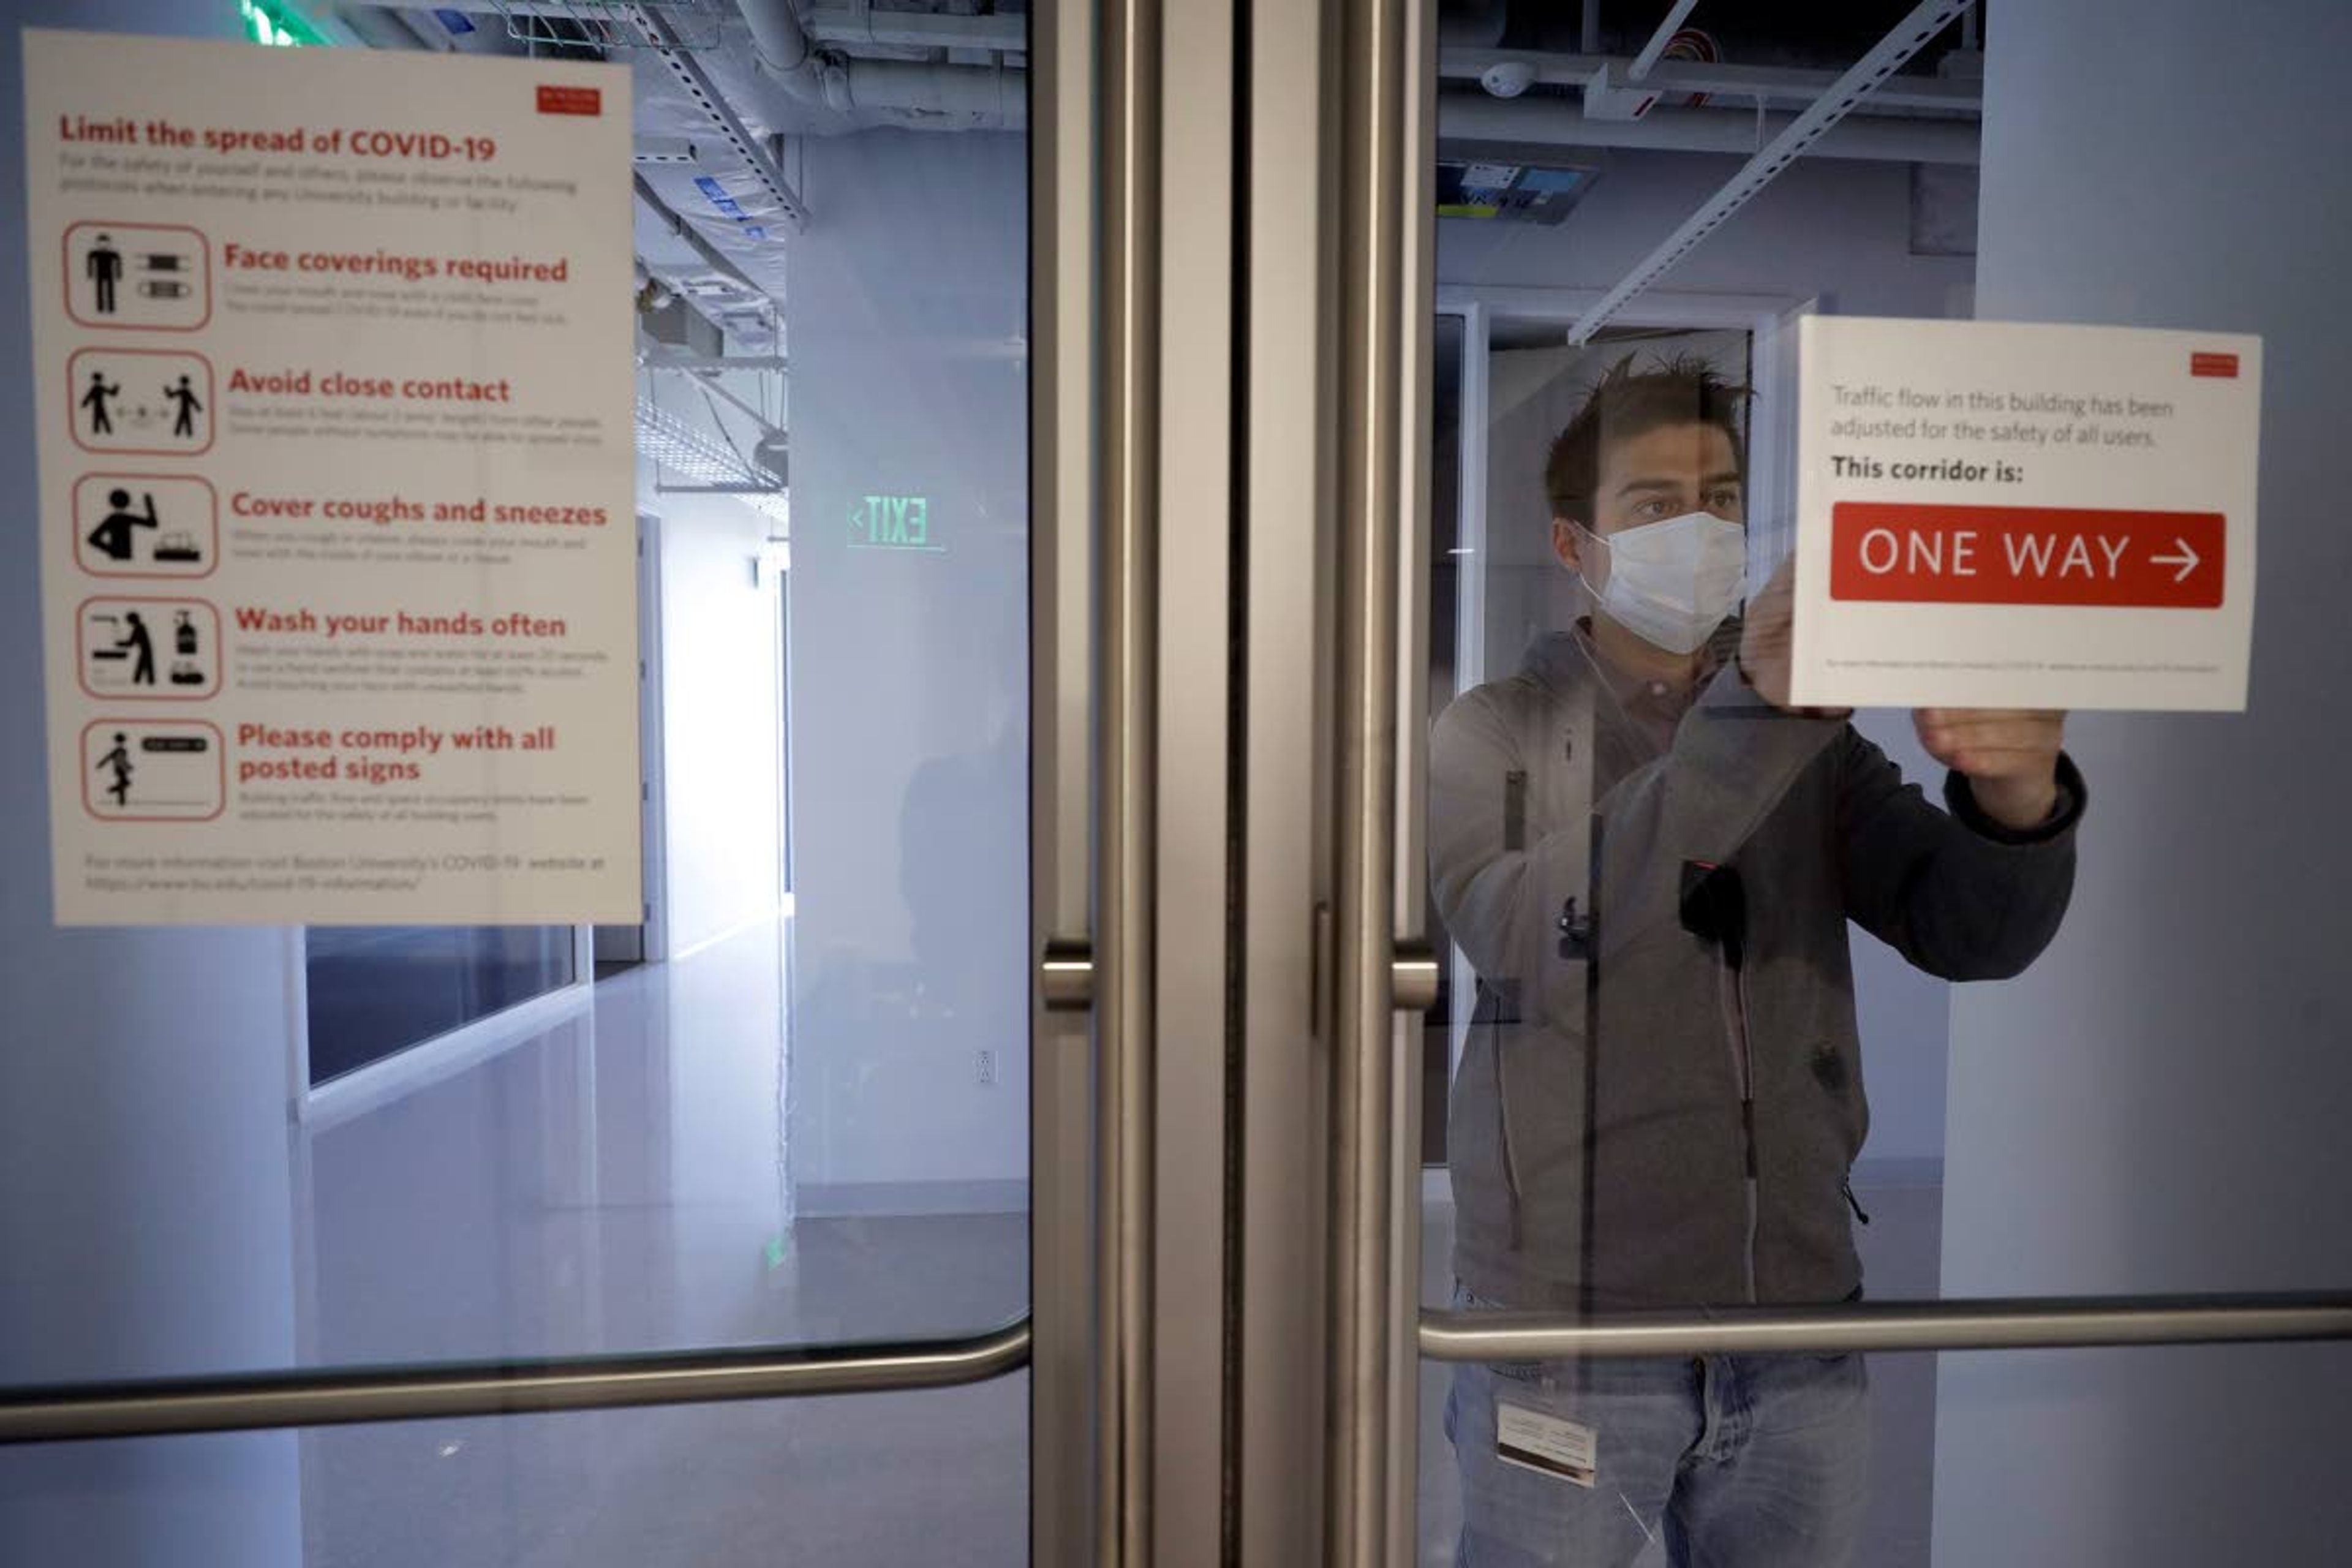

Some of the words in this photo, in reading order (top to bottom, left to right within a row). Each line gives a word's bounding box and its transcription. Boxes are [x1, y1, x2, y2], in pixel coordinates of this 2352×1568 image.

[61, 115, 137, 146] Limit
[146, 119, 196, 148] the
[204, 125, 305, 154] spread
[312, 129, 341, 154] of
[349, 129, 497, 160] COVID-19
[223, 241, 290, 270] Face
[297, 247, 438, 280] coverings
[444, 258, 568, 282] required
[227, 368, 312, 396] Avoid
[318, 371, 394, 399] close
[400, 377, 510, 402] contact
[1831, 384, 1893, 409] Traffic
[1898, 388, 1941, 409] flow
[1945, 392, 1964, 409] in
[1968, 391, 2005, 412] this
[2010, 392, 2087, 420] building
[2090, 396, 2124, 416] has
[2128, 398, 2174, 418] been
[1831, 417, 1918, 442] adjusted
[1920, 418, 1948, 440] for
[1953, 421, 1986, 440] the
[1990, 421, 2049, 447] safety
[2053, 423, 2074, 443] of
[2076, 424, 2100, 444] all
[2103, 429, 2157, 448] users.
[1831, 455, 1883, 478] This
[1890, 459, 1989, 481] corridor
[1996, 460, 2023, 483] is:
[230, 491, 314, 518] Cover
[323, 495, 425, 525] coughs
[434, 497, 488, 524] and
[494, 505, 608, 528] sneezes
[1860, 529, 1977, 575] ONE
[2003, 533, 2129, 578] WAY
[235, 608, 317, 633] Wash
[326, 615, 390, 641] your
[395, 611, 484, 637] hands
[489, 612, 566, 638] often
[236, 723, 332, 748] Please
[340, 725, 443, 754] comply
[451, 725, 513, 750] with
[520, 728, 557, 750] all
[238, 756, 338, 782] posted
[346, 757, 421, 784] signs
